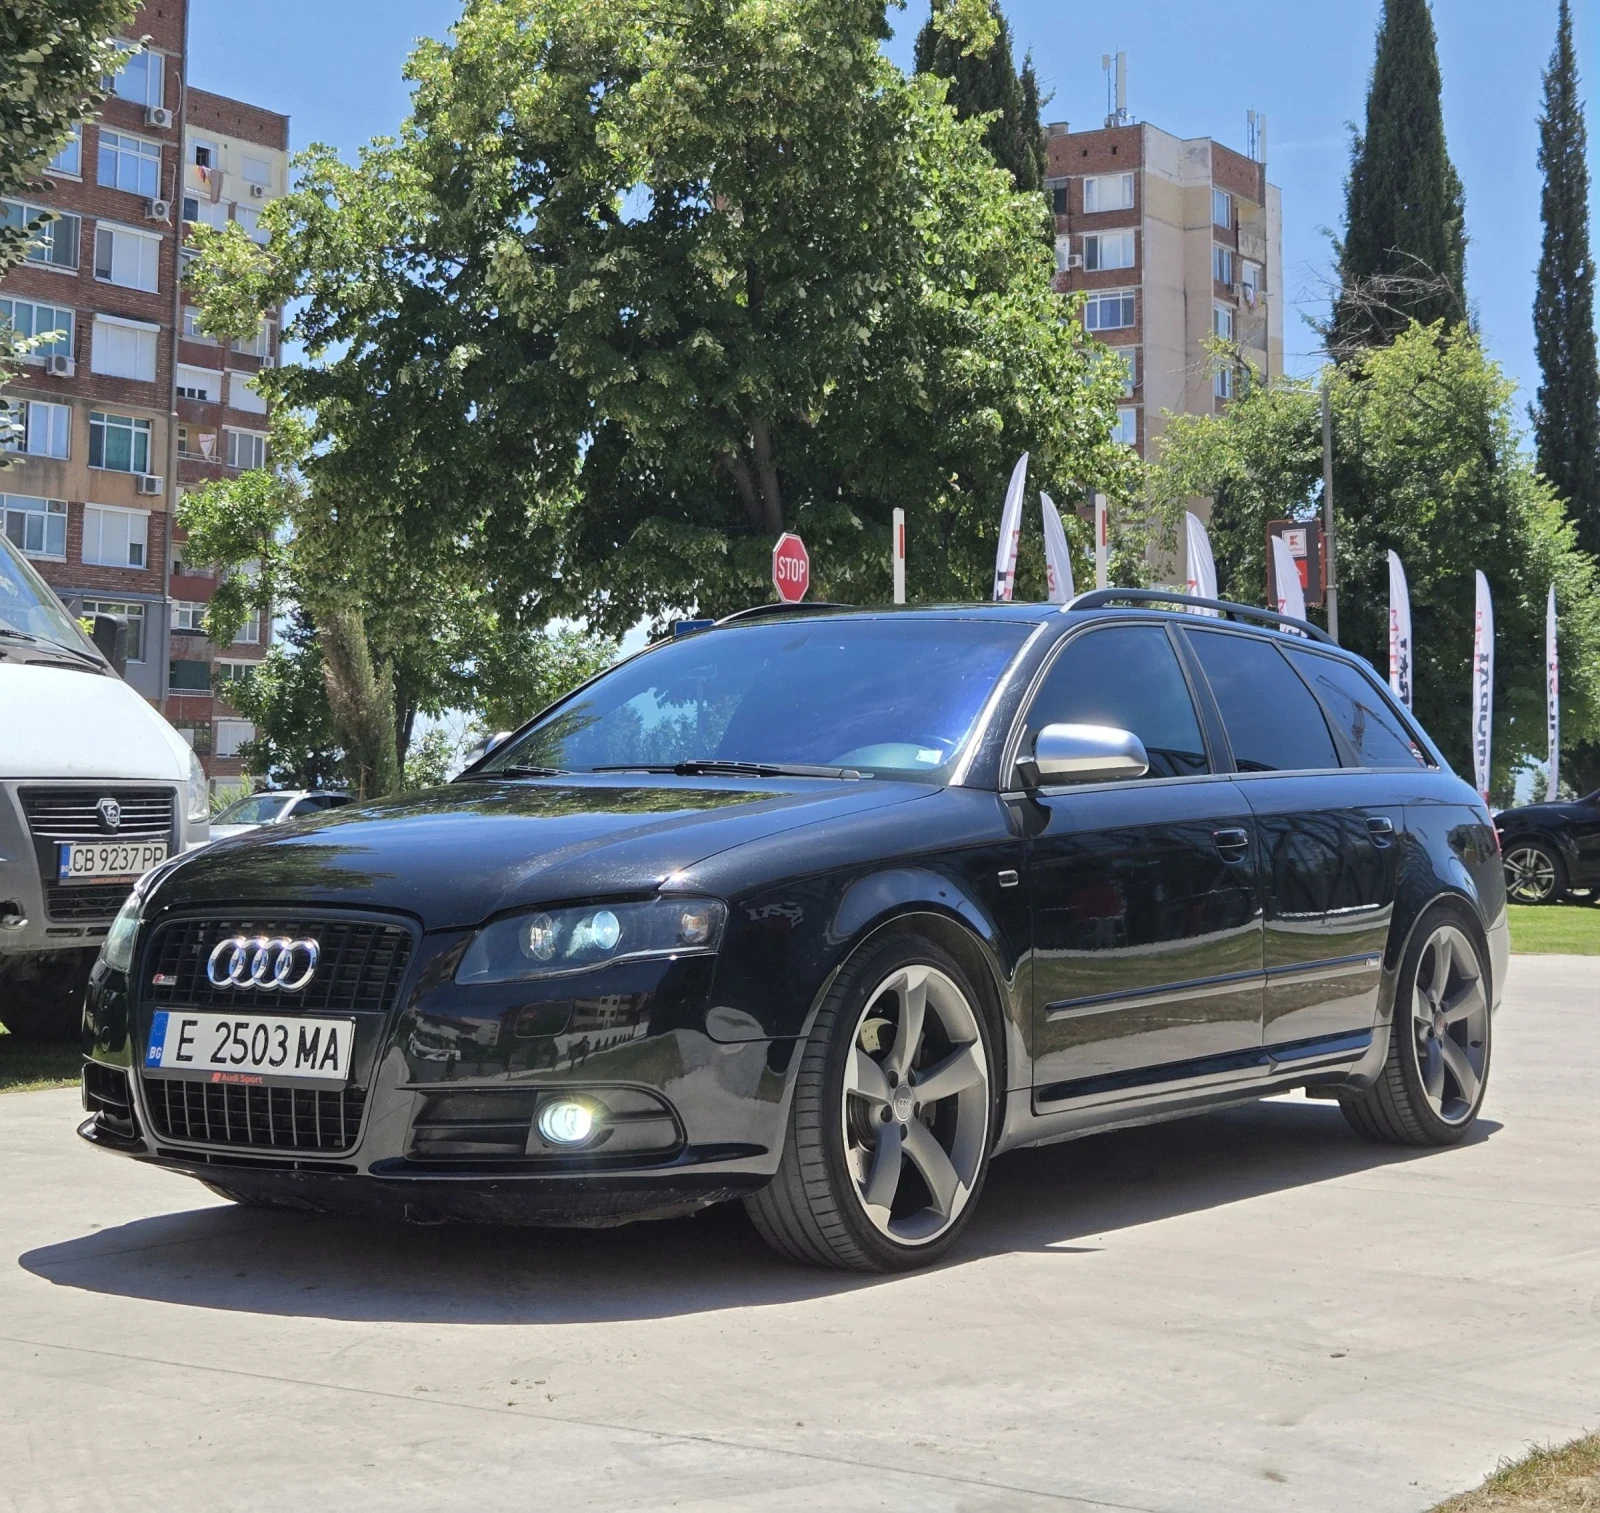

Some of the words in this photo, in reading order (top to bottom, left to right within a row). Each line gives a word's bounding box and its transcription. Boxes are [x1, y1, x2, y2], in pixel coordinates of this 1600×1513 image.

[778, 555, 806, 583] STOP
[72, 848, 95, 872] CB
[99, 847, 140, 872] 9237
[142, 846, 164, 870] PP
[148, 1046, 162, 1060] BG
[175, 1019, 198, 1062] E
[209, 1021, 289, 1067] 2503
[294, 1025, 339, 1071] MA
[221, 1072, 239, 1083] Audi
[240, 1074, 263, 1085] Sport
